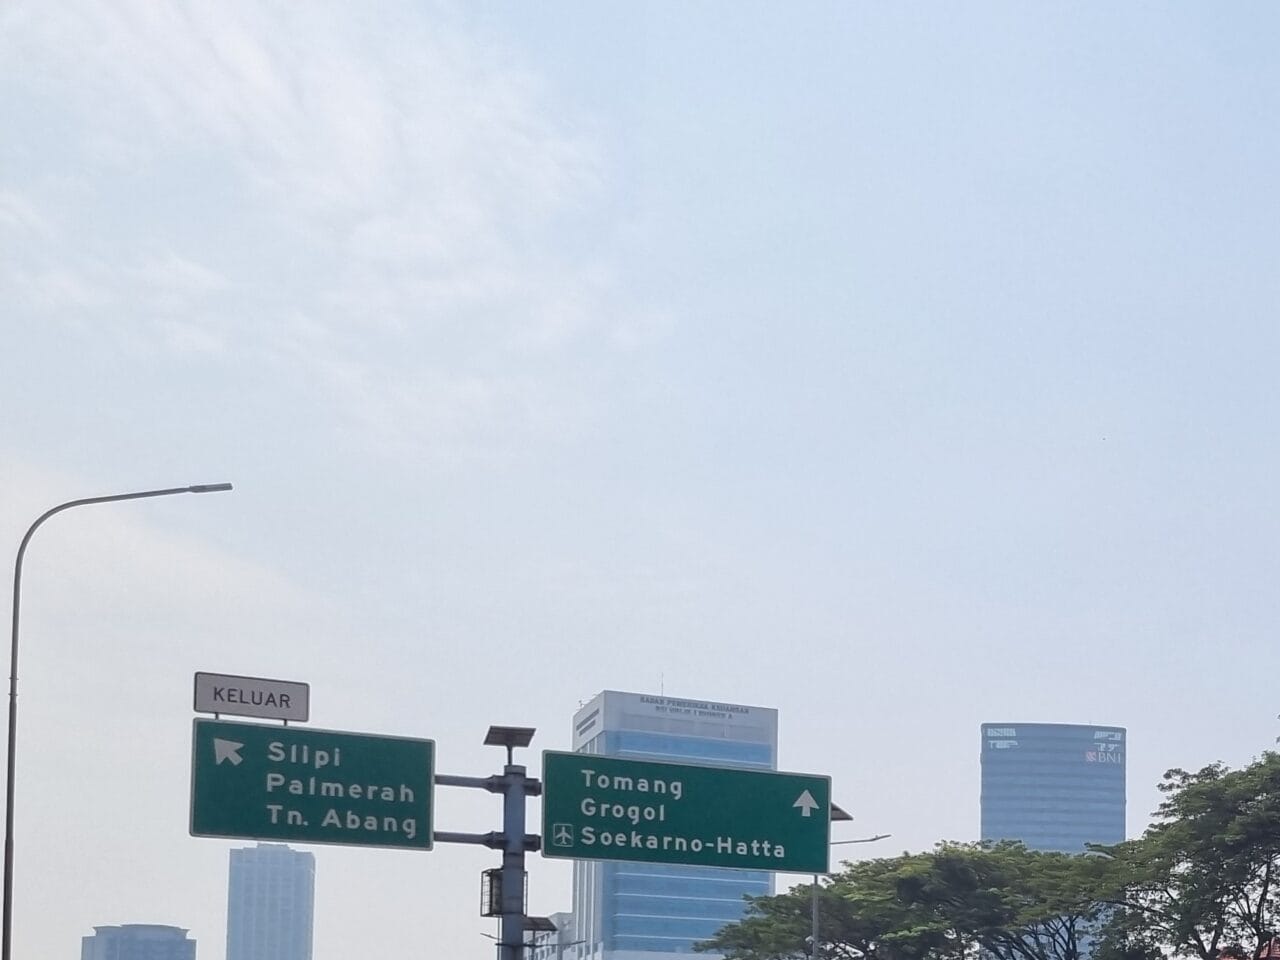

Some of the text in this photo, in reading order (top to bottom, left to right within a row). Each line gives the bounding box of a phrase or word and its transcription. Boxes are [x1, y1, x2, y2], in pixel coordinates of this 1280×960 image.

[213, 686, 291, 709] KELUAR
[267, 741, 341, 769] Slipi
[1099, 752, 1121, 764] BNI
[266, 773, 414, 802] Palmerah
[580, 769, 682, 800] Tomang
[266, 805, 416, 839] Tn. Abang
[580, 798, 665, 825] Grogol
[580, 827, 785, 858] Soekarno-Hatta
